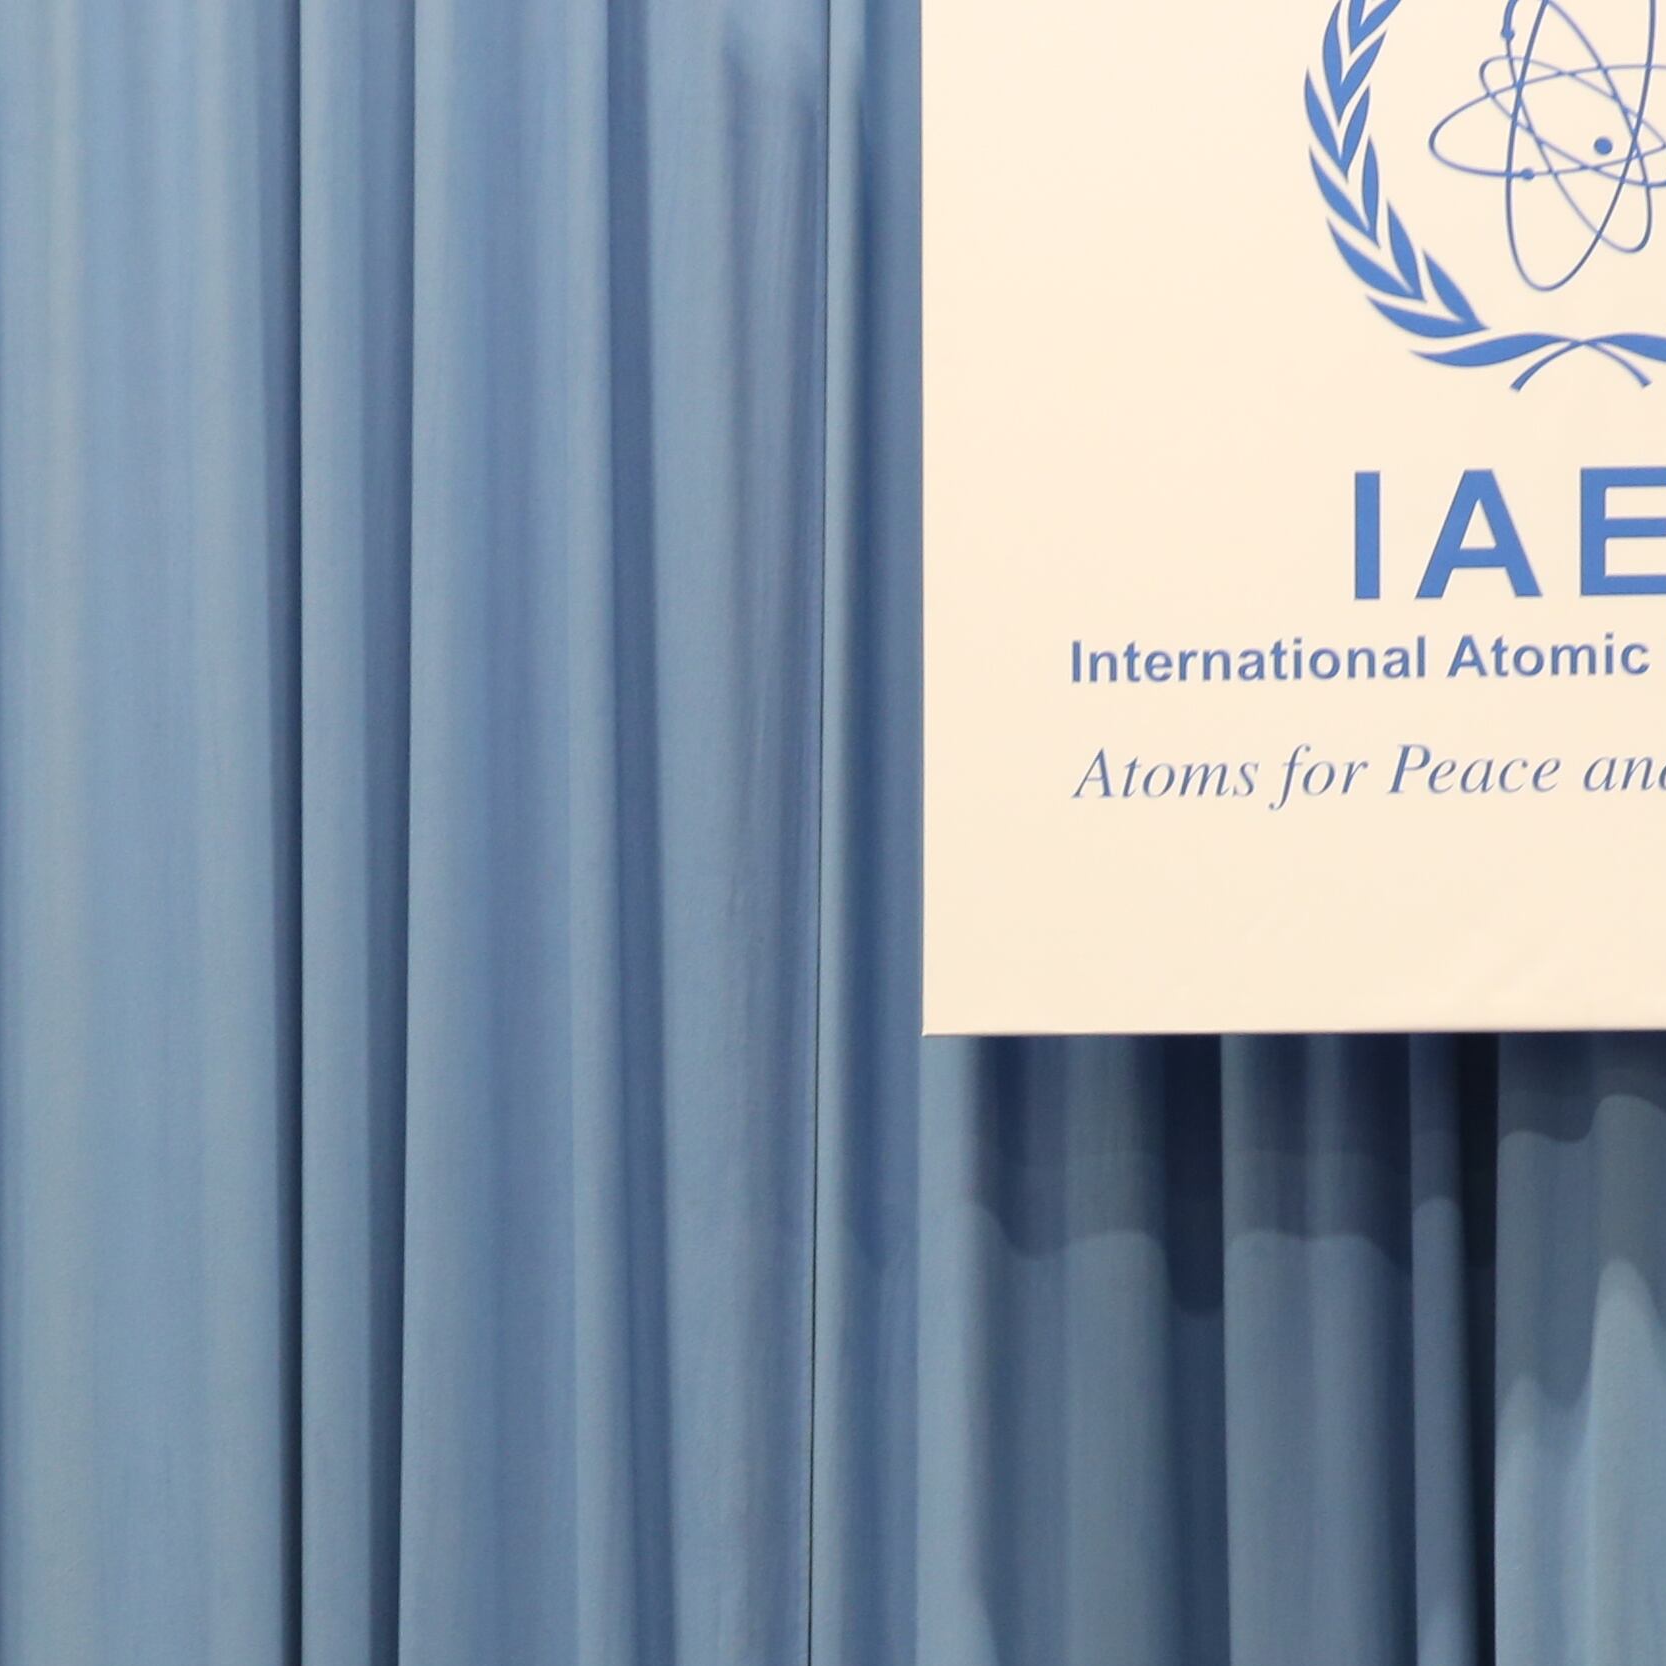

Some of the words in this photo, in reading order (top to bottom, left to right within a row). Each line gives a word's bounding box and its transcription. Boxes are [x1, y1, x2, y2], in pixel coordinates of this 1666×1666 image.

[1071, 638, 1428, 685] International
[1446, 633, 1651, 680] Atomic
[1071, 749, 1258, 800] Atoms
[1269, 745, 1369, 812] for
[1387, 742, 1562, 795] Peace
